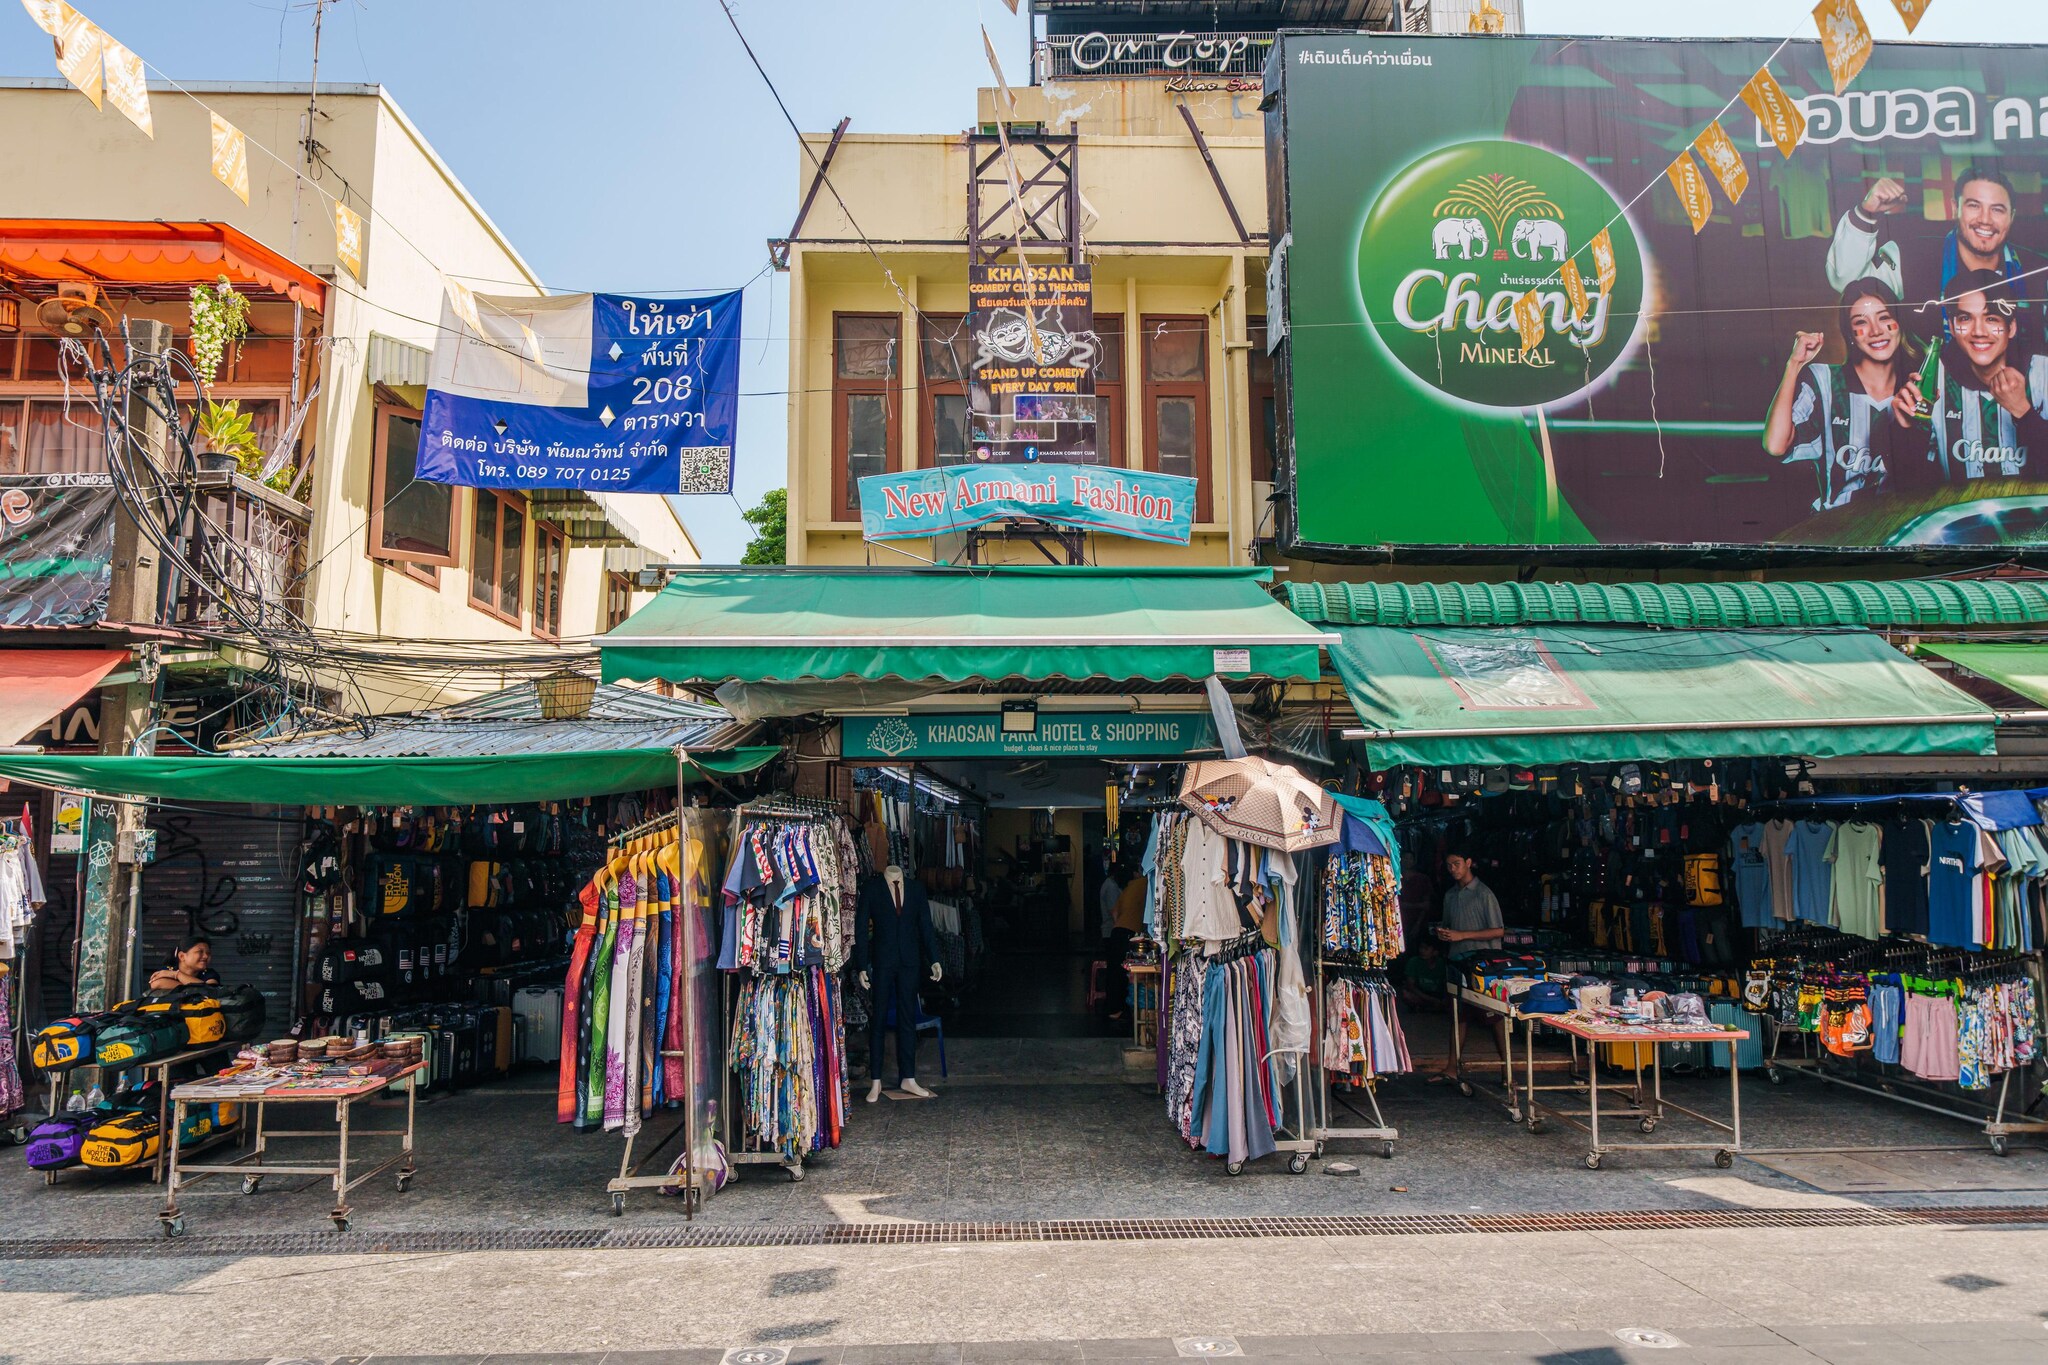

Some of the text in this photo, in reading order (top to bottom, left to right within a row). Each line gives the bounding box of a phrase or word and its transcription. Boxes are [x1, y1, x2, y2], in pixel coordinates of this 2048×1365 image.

[1070, 31, 1143, 72] On
[1298, 47, 1433, 66] #เติมเต็มคำว่าเพื่อน
[1832, 32, 1869, 70] SINGHA
[1165, 76, 1264, 94] Khao San
[1757, 86, 1976, 148] อบอล
[1762, 81, 1789, 142] SINGHA
[218, 137, 244, 181] SINGHA
[1684, 162, 1701, 219] SINGHA
[969, 283, 1011, 293] COMEDY
[1038, 283, 1047, 292] &
[1048, 282, 1090, 293] THEATRE
[987, 267, 1075, 281] KHAOSAN
[1569, 267, 1582, 312] SINGHA
[621, 300, 712, 335] ให้เช่า
[1393, 268, 1612, 348] Chang
[641, 338, 688, 366] พื้นที่
[980, 367, 1087, 380] STAND UP COMEDY
[991, 381, 1077, 394] EVERY DAY 9PM
[631, 375, 693, 405] 208
[623, 411, 705, 431] ตารางวา
[441, 430, 488, 453] ติดต่อ
[494, 438, 540, 457] บริษัท
[629, 439, 668, 458] จำกัด
[1952, 438, 2028, 468] Chang
[478, 460, 631, 481] โทร. 089 707 0125
[1836, 444, 1888, 474] Cha
[882, 475, 1174, 522] New Armani Fashion
[928, 724, 996, 743] KHAOSAN
[1042, 723, 1087, 742] HOTEL
[1091, 723, 1102, 741] &
[1106, 722, 1180, 742] SHOPPING
[1003, 745, 1023, 753] budget
[1027, 744, 1043, 752] clean
[1049, 744, 1062, 752] nice
[1062, 744, 1079, 753] place
[1079, 744, 1086, 752] to
[1086, 745, 1099, 753] stay
[1237, 829, 1271, 844] GUCCI
[385, 872, 394, 897] FACE
[393, 863, 402, 897] NORTH
[401, 878, 409, 897] THE
[86, 1149, 109, 1157] NORTH
